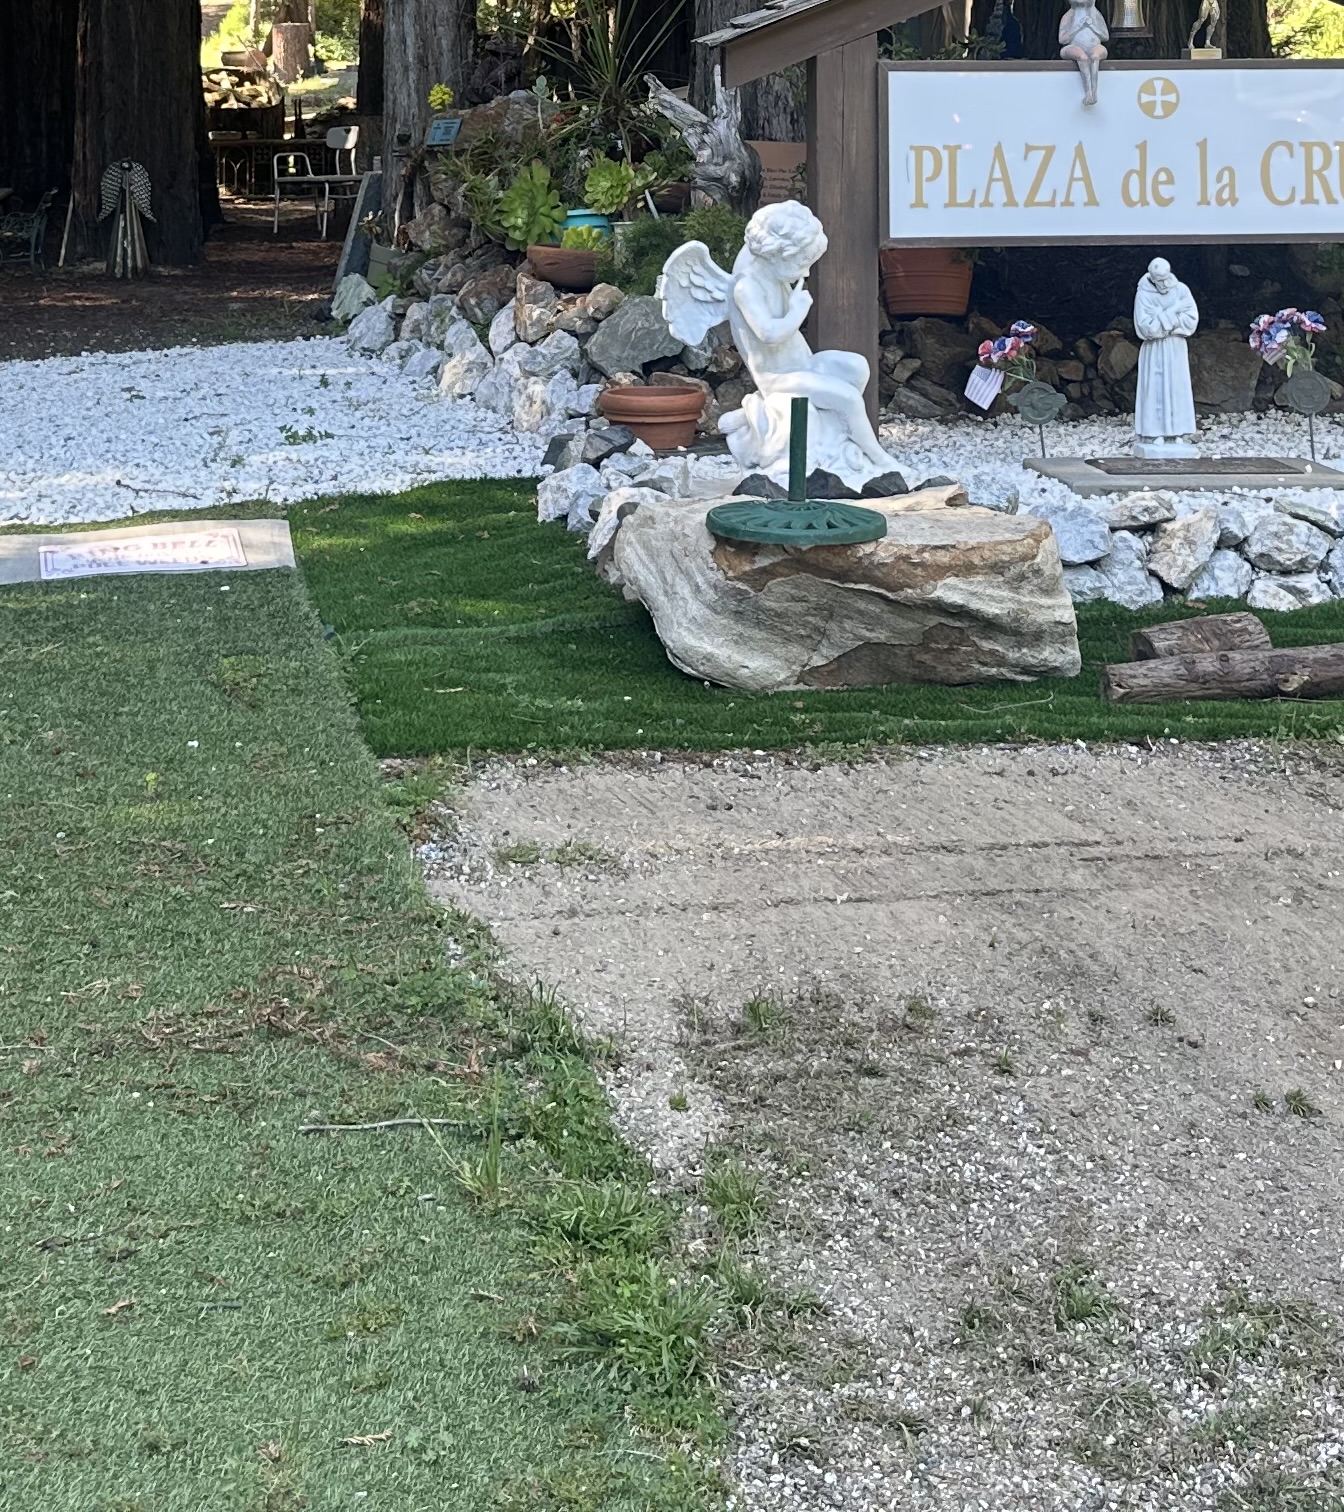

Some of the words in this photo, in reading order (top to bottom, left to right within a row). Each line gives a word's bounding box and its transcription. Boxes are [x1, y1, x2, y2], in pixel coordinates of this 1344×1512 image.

[909, 141, 1100, 209] PLAZA
[1121, 140, 1176, 207] de
[1196, 138, 1239, 207] la
